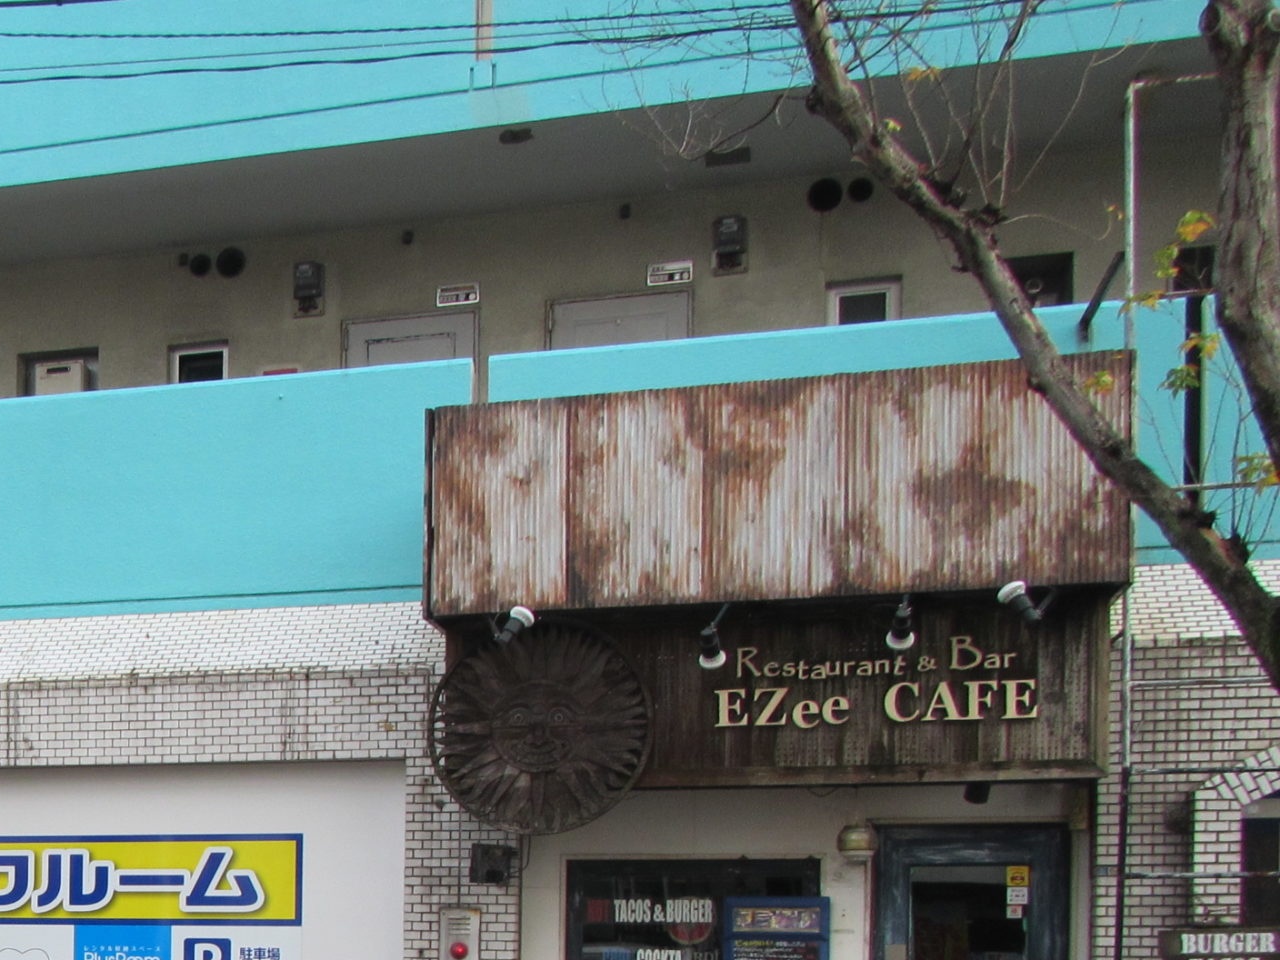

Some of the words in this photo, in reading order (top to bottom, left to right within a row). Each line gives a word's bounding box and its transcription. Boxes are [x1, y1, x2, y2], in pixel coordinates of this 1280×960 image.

[737, 647, 906, 680] Restaurant
[917, 656, 937, 671] &
[949, 636, 1017, 670] Bar
[714, 688, 850, 728] EZee
[884, 679, 1039, 723] CAFE
[614, 899, 651, 923] TACOS
[653, 904, 665, 922] &
[666, 899, 713, 923] BURGER
[239, 947, 280, 960] 駐車場
[1180, 932, 1276, 954] BURGER
